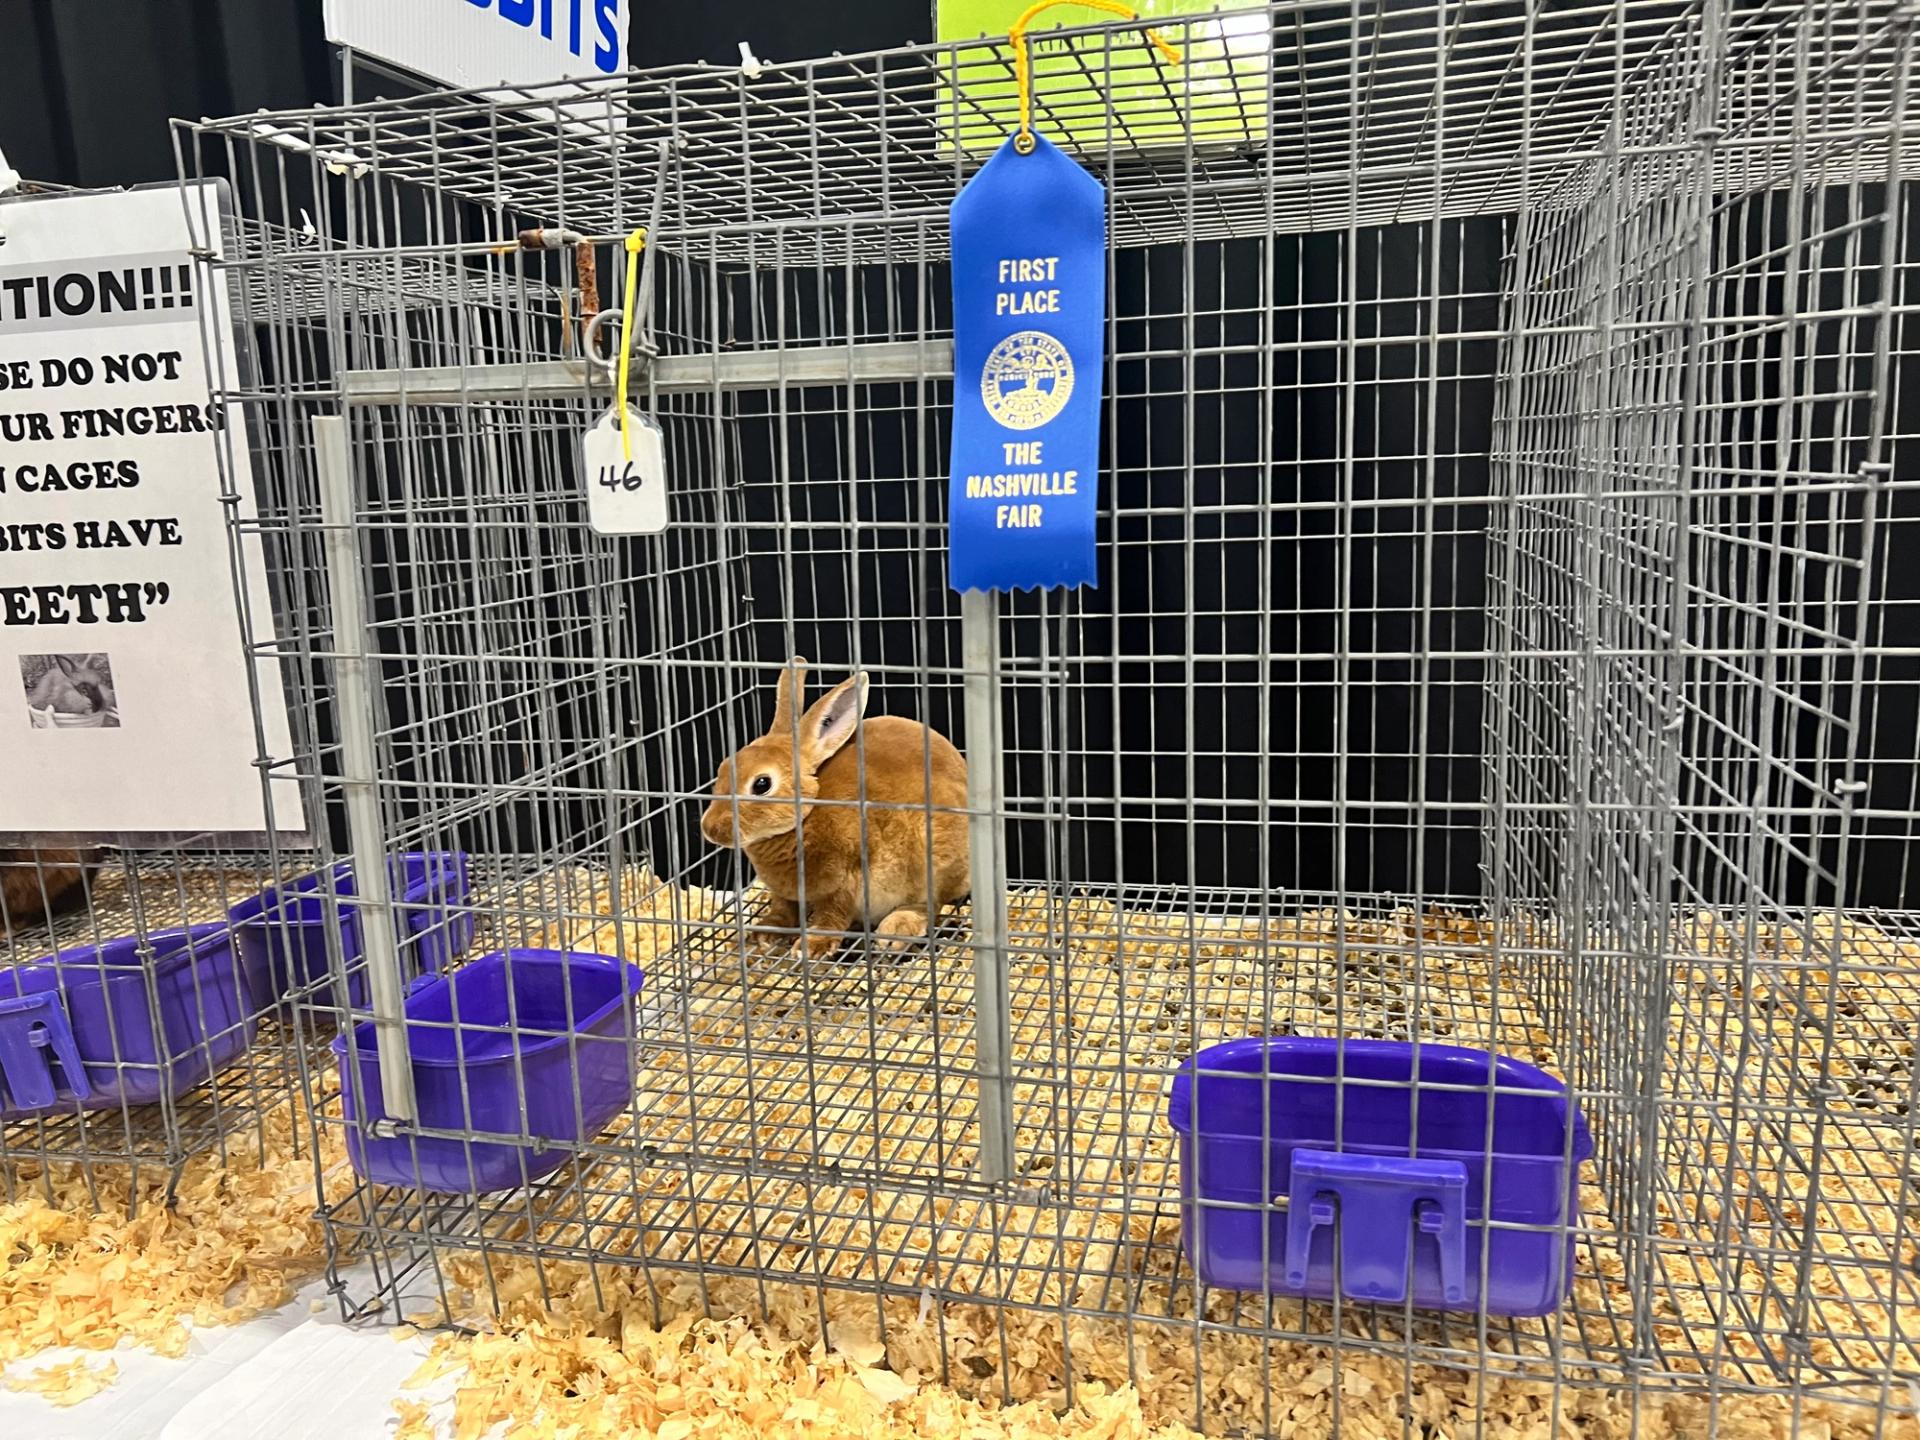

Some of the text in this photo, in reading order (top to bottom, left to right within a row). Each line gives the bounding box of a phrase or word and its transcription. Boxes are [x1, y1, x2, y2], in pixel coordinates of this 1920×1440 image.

[999, 257, 1059, 283] FIRST
[0, 264, 193, 320] TION!!!
[996, 290, 1060, 316] PLACE
[40, 357, 93, 387] DO
[101, 351, 182, 383] NOT
[60, 403, 226, 438] FINGERS
[1003, 441, 1043, 466] THE
[16, 461, 139, 492] CAGES
[600, 461, 642, 492] 46
[966, 471, 1078, 498] NASHVILLE
[996, 504, 1042, 528] FAIR
[74, 518, 182, 548] HAVE
